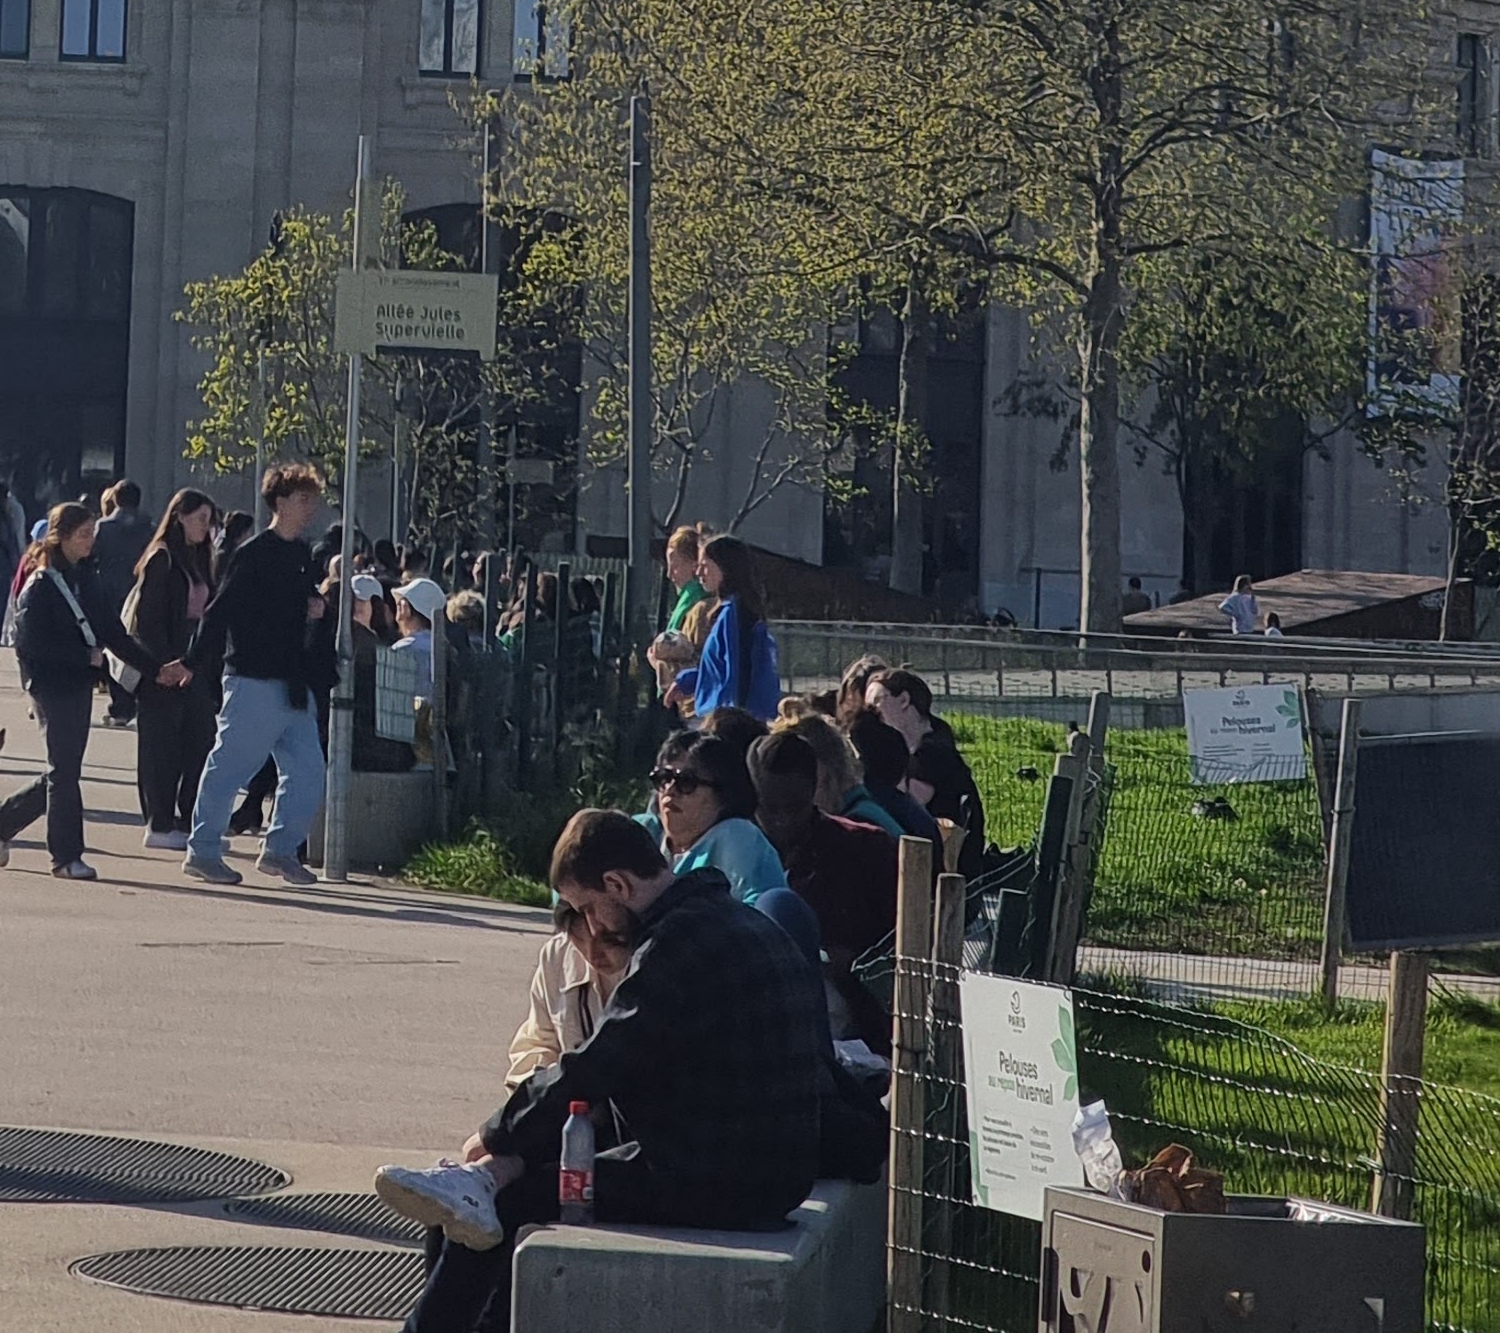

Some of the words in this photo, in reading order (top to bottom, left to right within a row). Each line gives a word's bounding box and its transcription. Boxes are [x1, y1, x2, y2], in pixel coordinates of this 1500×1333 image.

[376, 303, 414, 319] Allée
[420, 305, 462, 322] Jules
[375, 321, 465, 340] Supervielle
[1008, 1014, 1026, 1029] PARIS
[999, 1050, 1038, 1080] Pelouses
[1016, 1076, 1054, 1106] hivernal
